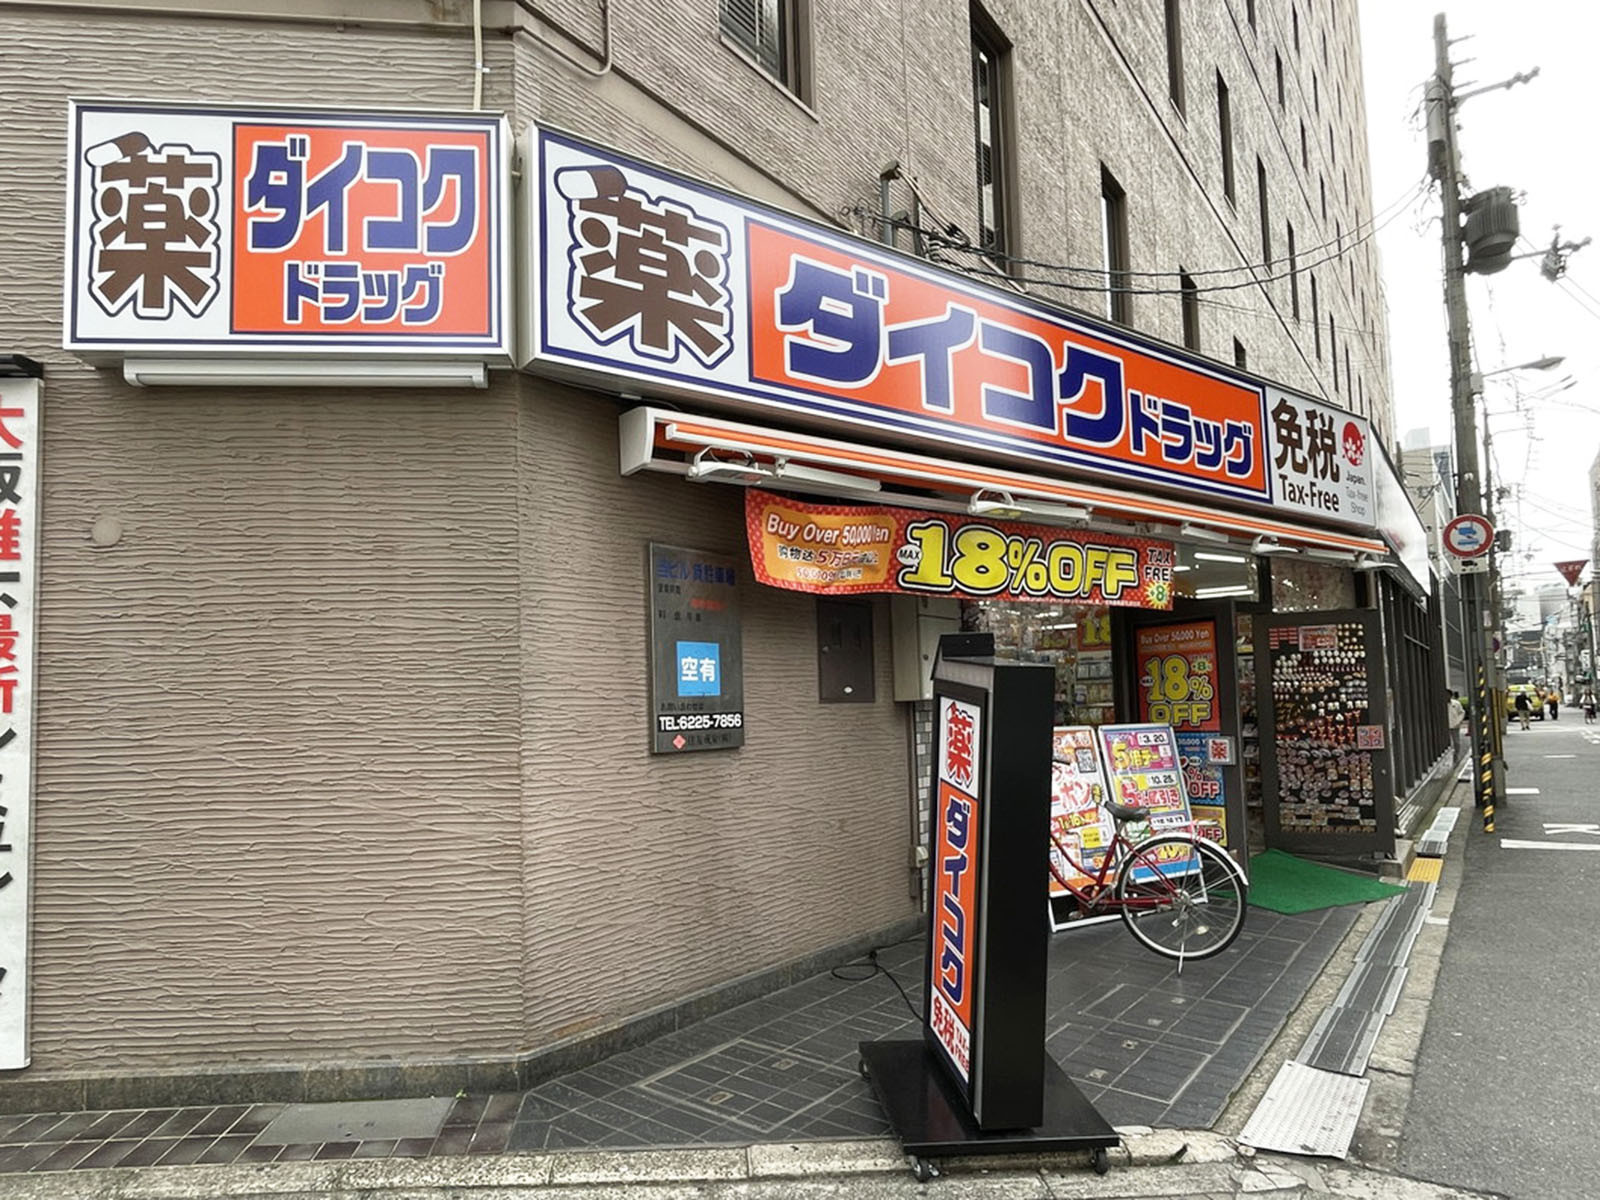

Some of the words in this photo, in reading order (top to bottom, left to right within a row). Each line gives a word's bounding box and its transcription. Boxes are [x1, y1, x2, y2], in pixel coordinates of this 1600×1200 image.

[246, 136, 480, 254] ダイコク
[87, 132, 221, 319] 薬
[284, 262, 445, 324] ドラッグ
[555, 166, 733, 368] 薬
[774, 254, 1126, 450] ダイコク
[1127, 389, 1255, 480] ドラッグ
[1270, 397, 1340, 483] 免税
[1279, 473, 1340, 512] Tax-Free
[767, 513, 799, 540] Buy
[803, 523, 840, 544] Over
[898, 548, 921, 560] MAX
[1147, 548, 1172, 566] TAX
[1144, 566, 1174, 583] FRE
[681, 656, 716, 682] 空有
[1149, 701, 1212, 726] OFF
[946, 701, 974, 788] 薬
[1189, 781, 1219, 798] OFF
[942, 795, 971, 1006] ダイコク
[933, 995, 955, 1055] 免税
